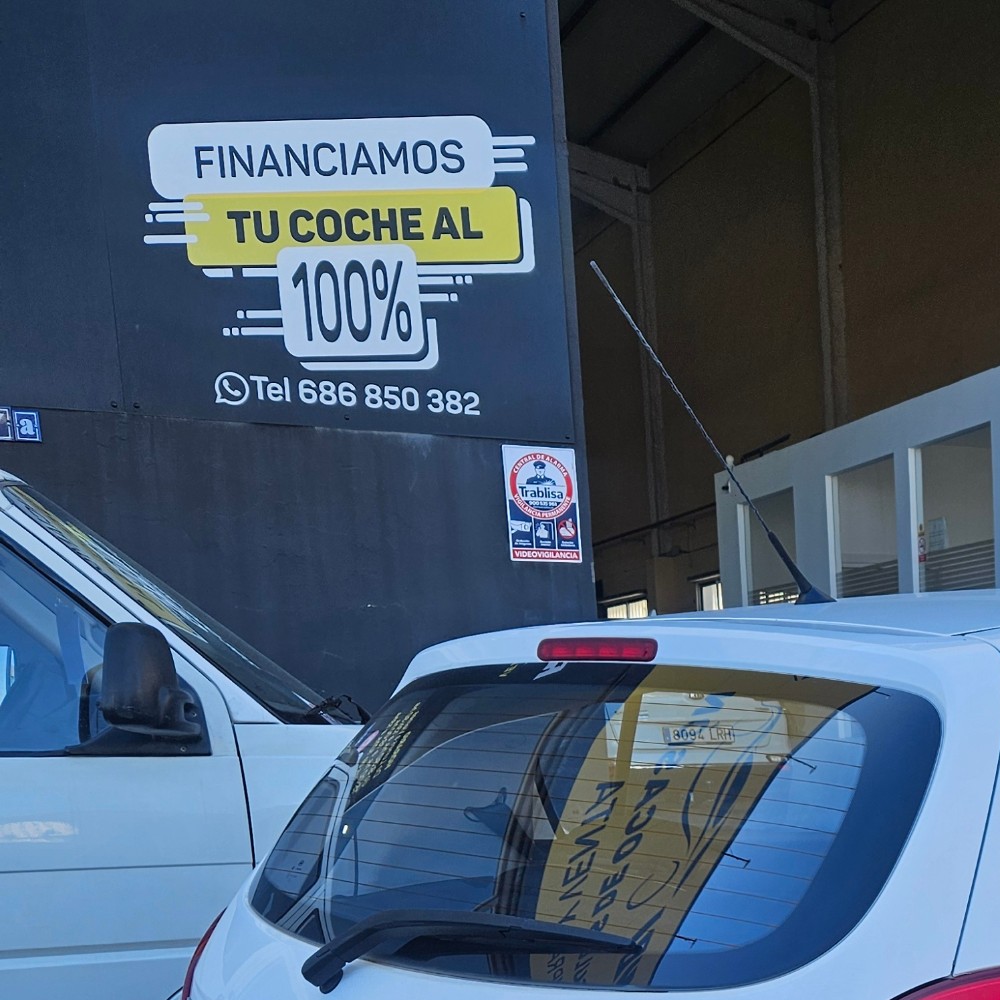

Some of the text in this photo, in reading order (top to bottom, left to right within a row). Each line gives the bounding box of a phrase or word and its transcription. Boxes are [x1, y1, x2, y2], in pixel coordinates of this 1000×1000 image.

[194, 139, 465, 179] FINANCIAMOS
[226, 206, 484, 244] TU COCHE AL
[291, 258, 413, 343] 100%
[250, 375, 481, 416] Tel 686 850 382
[19, 418, 35, 435] a
[513, 454, 536, 474] CENTRAL
[545, 455, 568, 477] ALARMA
[518, 485, 564, 499] Trablisa
[514, 493, 571, 518] VIGILANCIA PERMANENTE
[514, 550, 578, 559] VIDEOVIGILANCIA
[672, 728, 705, 741] 8094
